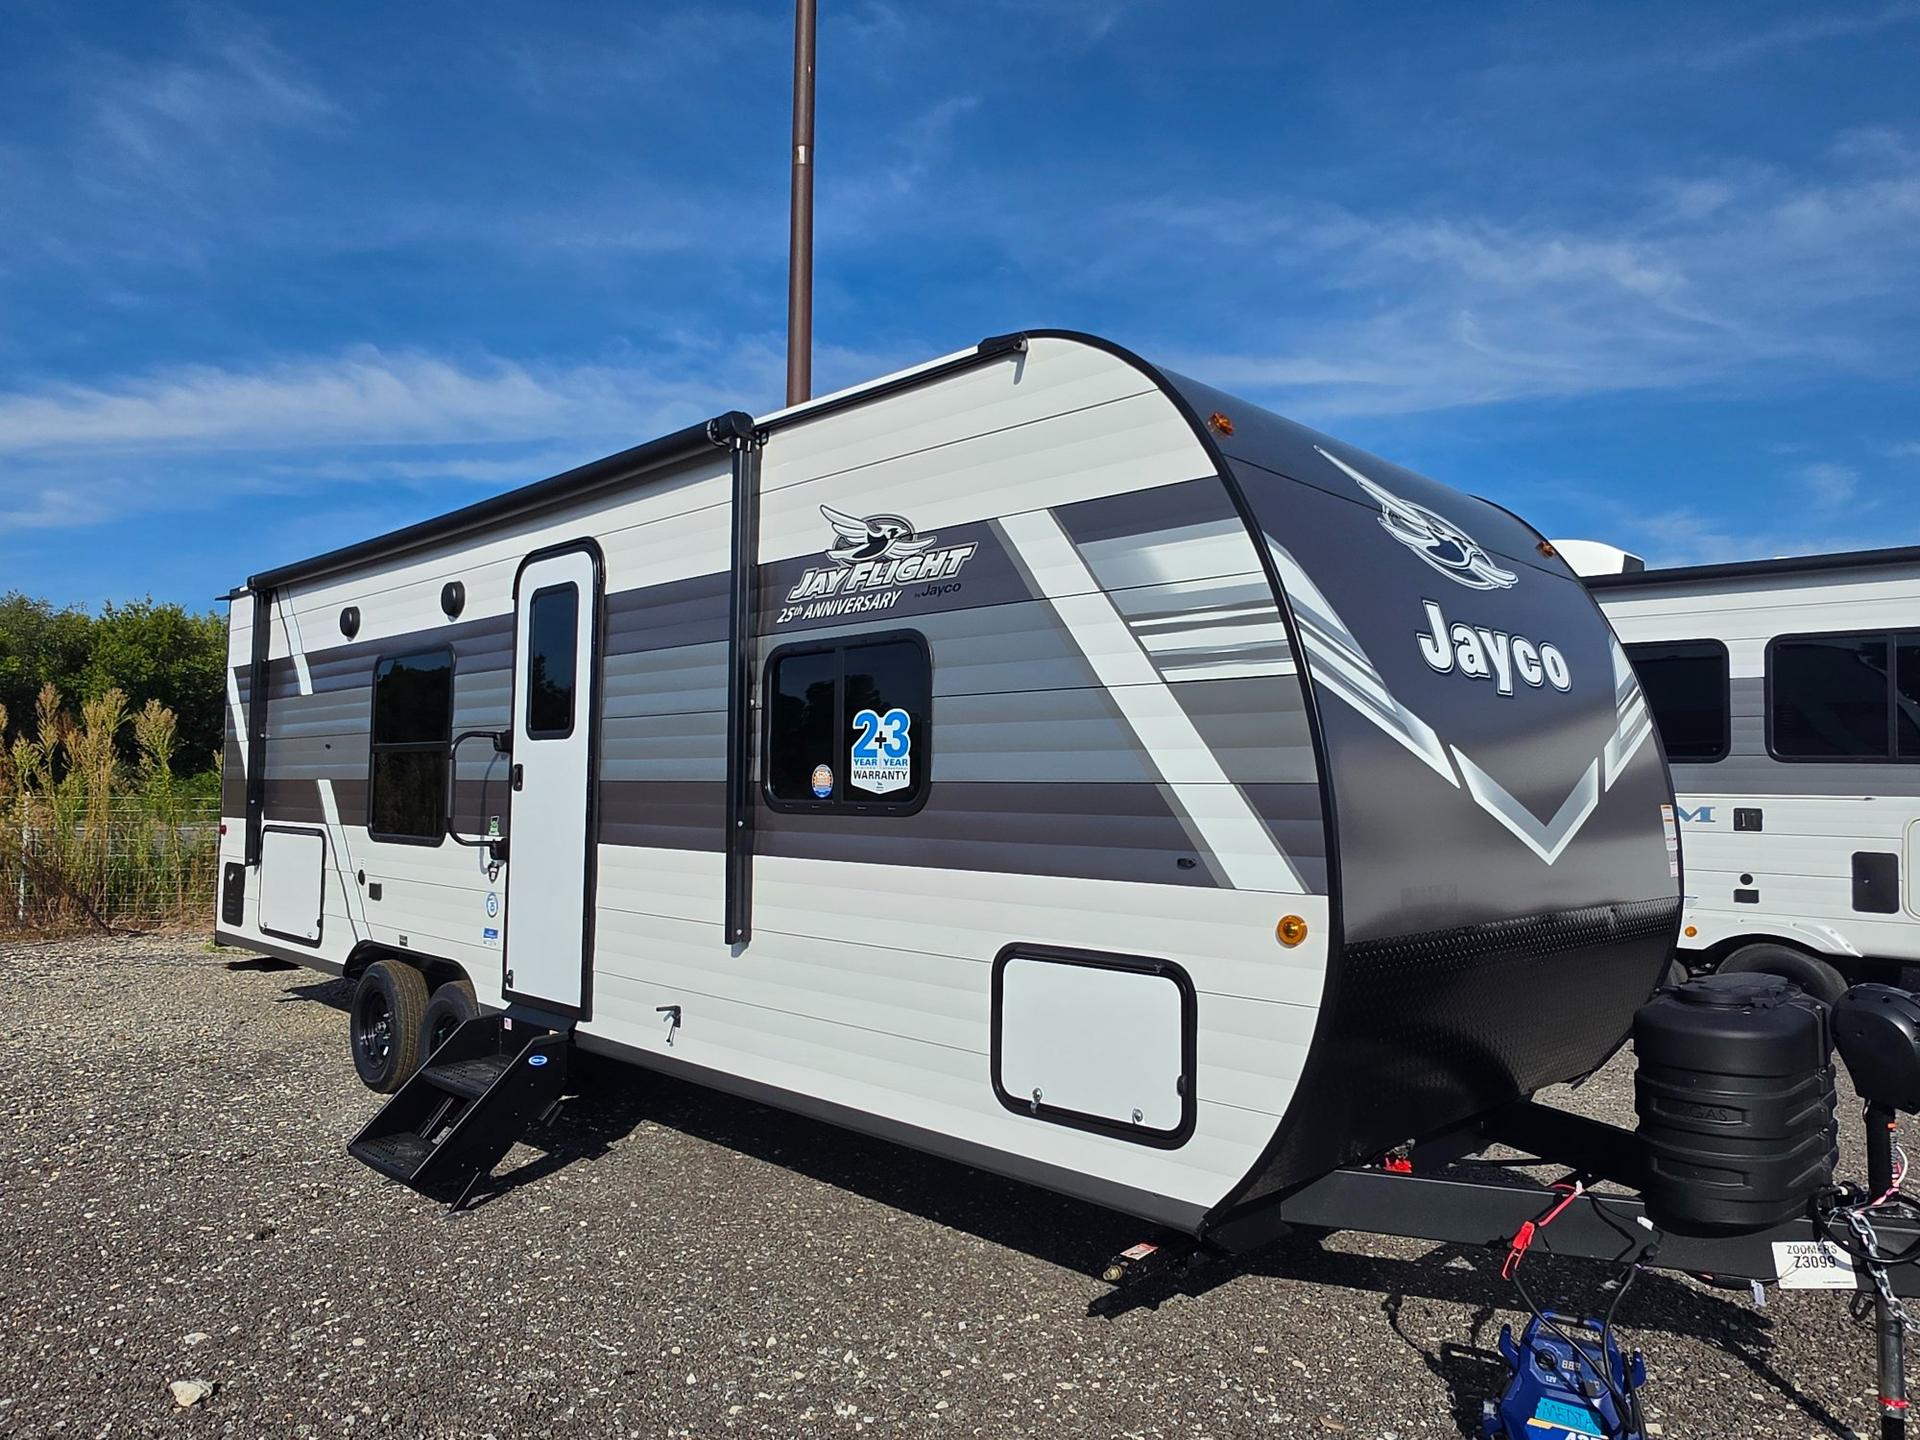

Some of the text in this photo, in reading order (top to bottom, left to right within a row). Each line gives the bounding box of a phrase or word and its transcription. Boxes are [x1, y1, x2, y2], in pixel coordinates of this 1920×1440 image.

[787, 545, 975, 601] JAY FLIGHT
[921, 583, 961, 597] Jayco
[776, 590, 903, 624] 25th ANNIVERSARY
[1417, 600, 1572, 695] Jayco
[853, 758, 908, 767] YEAR YEAR
[853, 770, 908, 780] WARRANTY
[1793, 1256, 1836, 1269] Z3099
